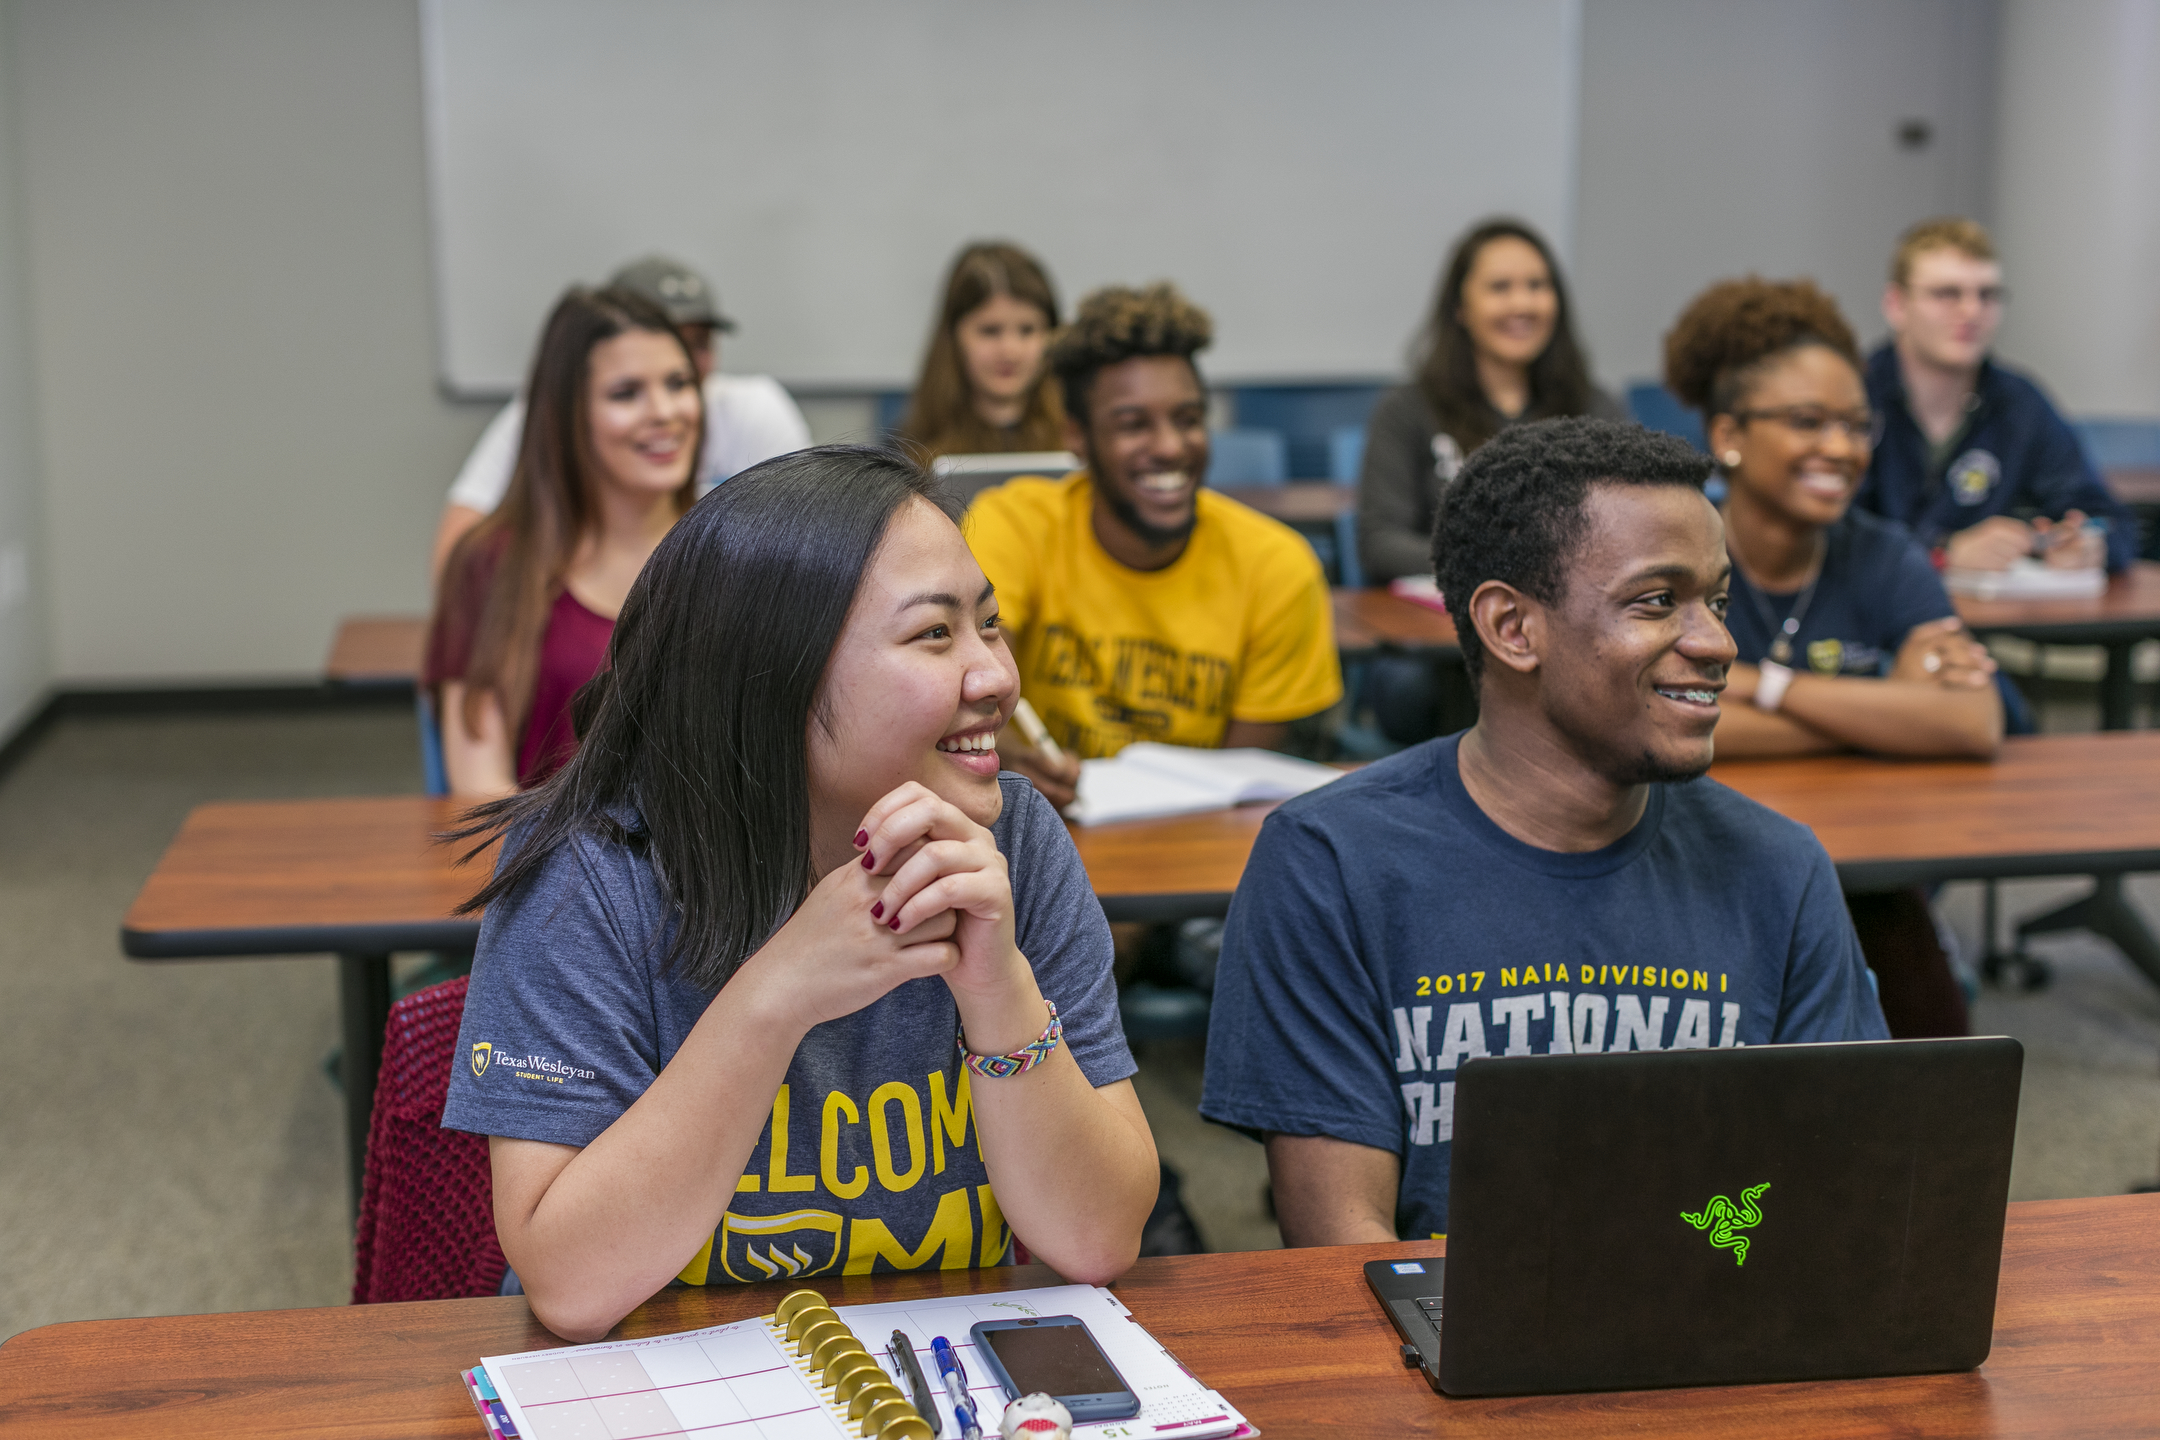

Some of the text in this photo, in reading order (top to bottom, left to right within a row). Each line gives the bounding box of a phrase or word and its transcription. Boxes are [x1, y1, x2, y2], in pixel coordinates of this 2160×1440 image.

[1416, 971, 1486, 996] 2017
[1500, 963, 1570, 987] NAIA
[1581, 965, 1709, 992] DIVISION
[1393, 991, 1745, 1073] NATIONAL
[515, 1071, 564, 1084] STUDENT LIFE
[736, 1060, 985, 1200] LCOM
[1102, 1427, 1132, 1439] 15
